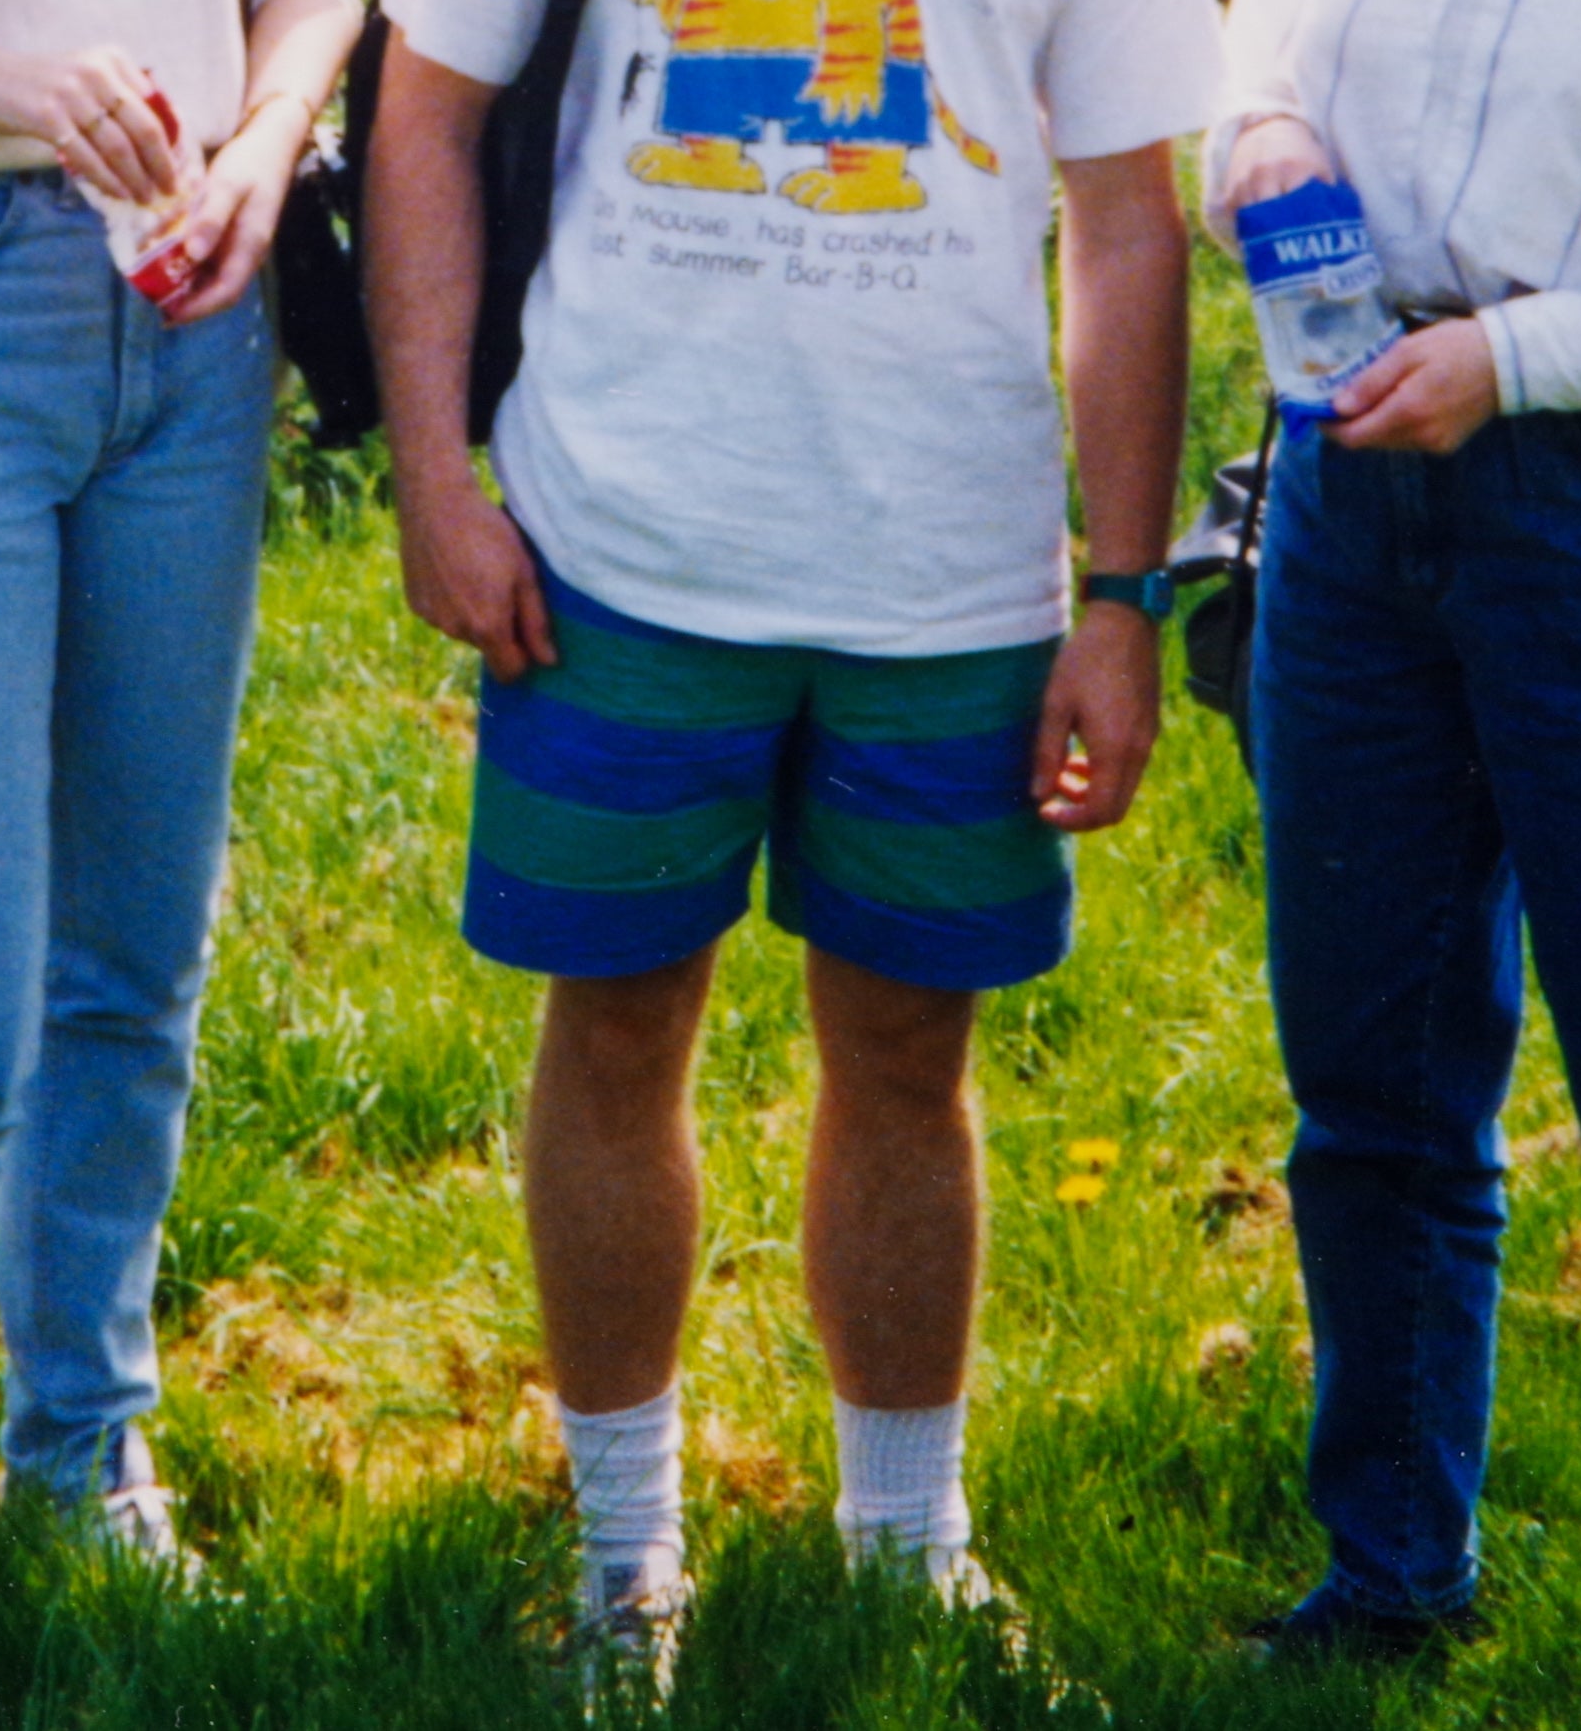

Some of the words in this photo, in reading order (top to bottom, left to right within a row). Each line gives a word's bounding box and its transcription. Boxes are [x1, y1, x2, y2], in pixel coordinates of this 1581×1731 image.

[755, 217, 805, 249] has
[822, 228, 934, 258] crashed
[648, 240, 766, 279] summer
